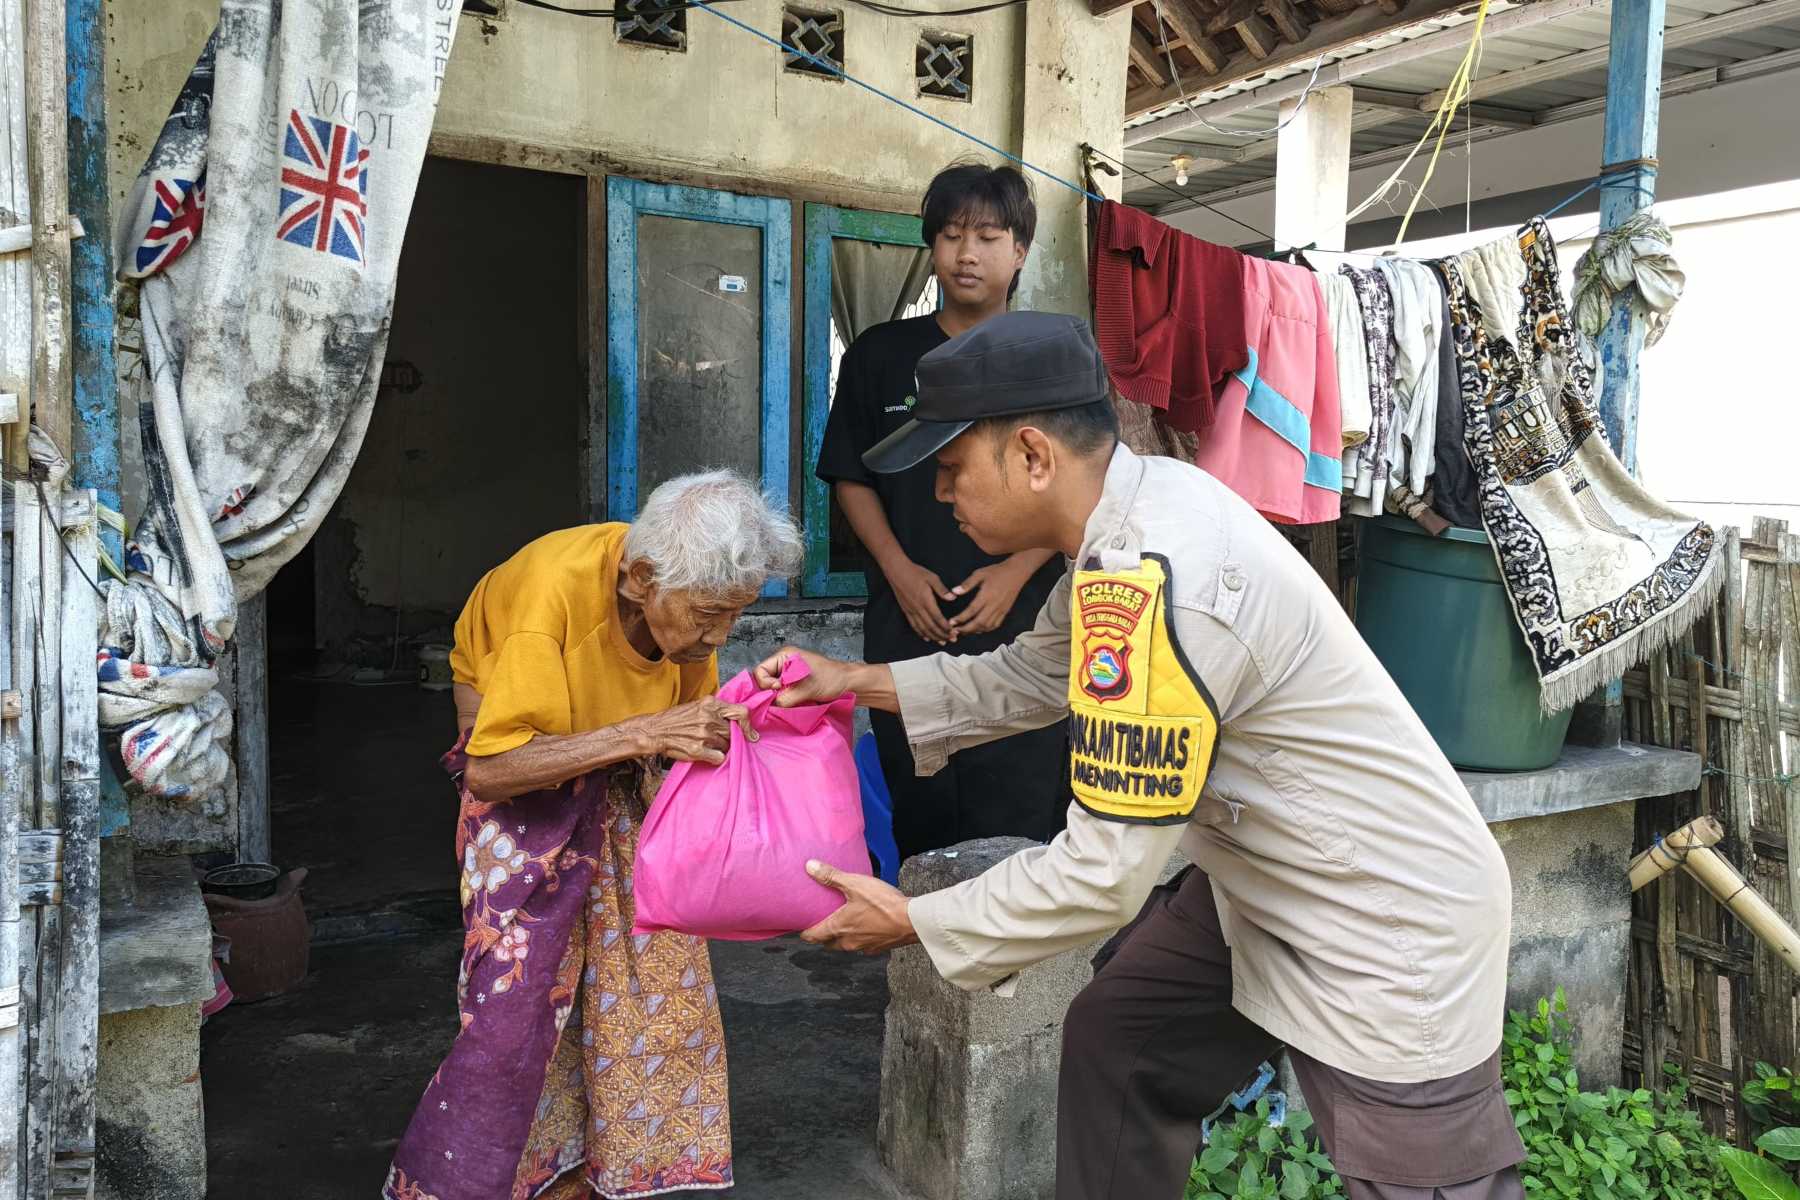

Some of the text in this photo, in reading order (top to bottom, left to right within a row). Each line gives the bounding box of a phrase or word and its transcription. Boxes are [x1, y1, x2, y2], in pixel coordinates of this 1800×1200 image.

[433, 0, 453, 108] STREE
[306, 77, 395, 150] LODON
[1080, 583, 1144, 604] POLRES
[1114, 596, 1141, 612] BARAT
[1074, 759, 1183, 798] MENINTING
